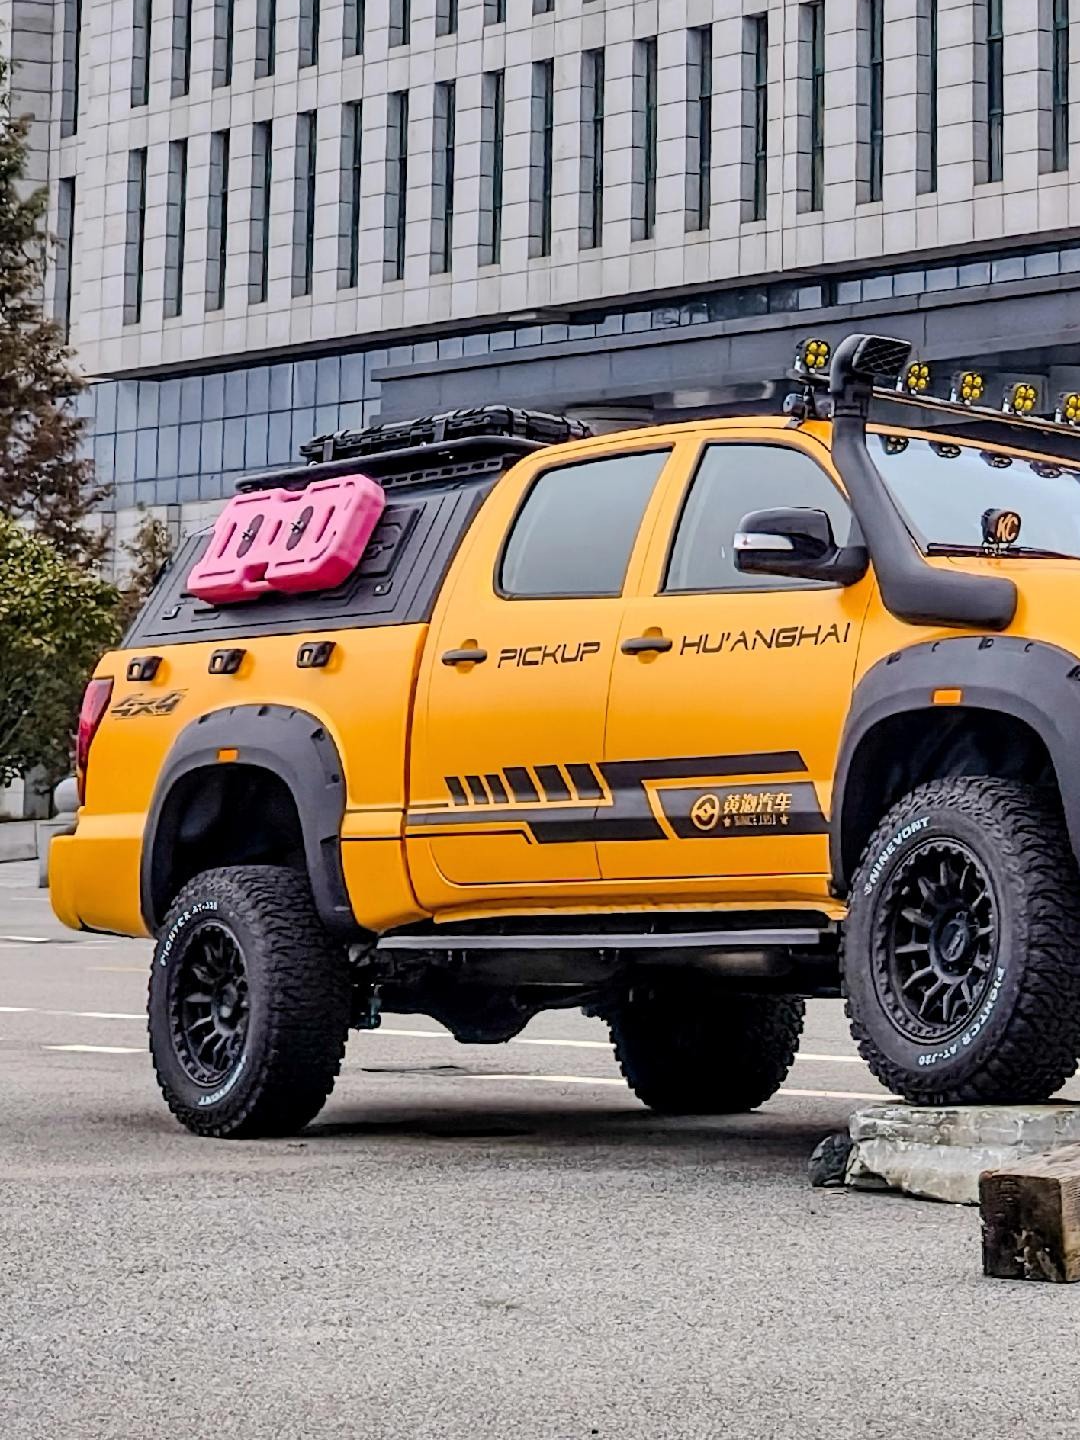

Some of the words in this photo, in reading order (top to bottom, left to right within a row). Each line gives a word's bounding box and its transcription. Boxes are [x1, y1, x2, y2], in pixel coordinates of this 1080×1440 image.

[996, 513, 1019, 542] KC
[679, 622, 851, 656] HU'ANGHAI
[497, 641, 601, 669] PICKUP
[723, 792, 793, 814] 黄海汽车
